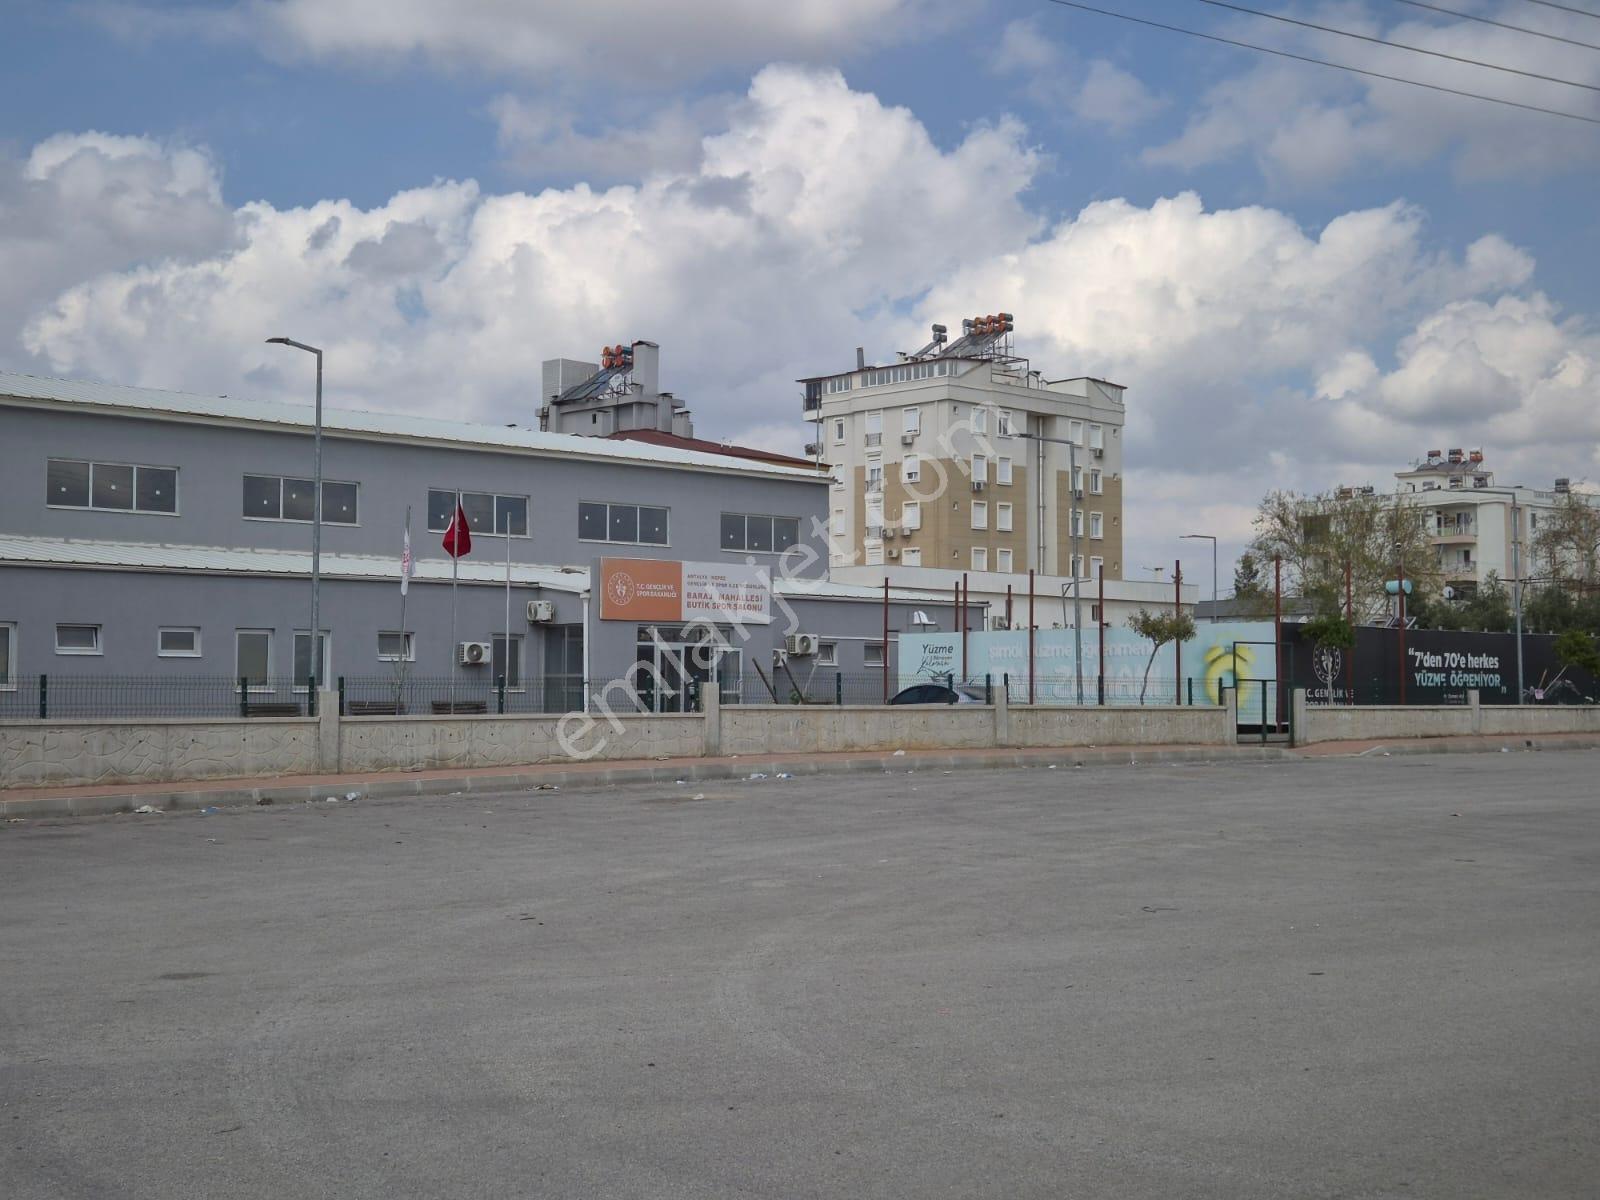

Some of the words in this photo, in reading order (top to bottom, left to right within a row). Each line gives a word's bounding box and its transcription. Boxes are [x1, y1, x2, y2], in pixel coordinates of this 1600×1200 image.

[686, 592, 713, 600] BARAJ
[686, 601, 711, 609] BUTİK
[712, 602, 731, 610] SPOR
[732, 602, 763, 612] SALONU
[922, 643, 953, 654] Yüzme
[1443, 652, 1466, 668] 70'e
[1467, 652, 1499, 669] herkes
[1314, 688, 1344, 698] GENLİK
